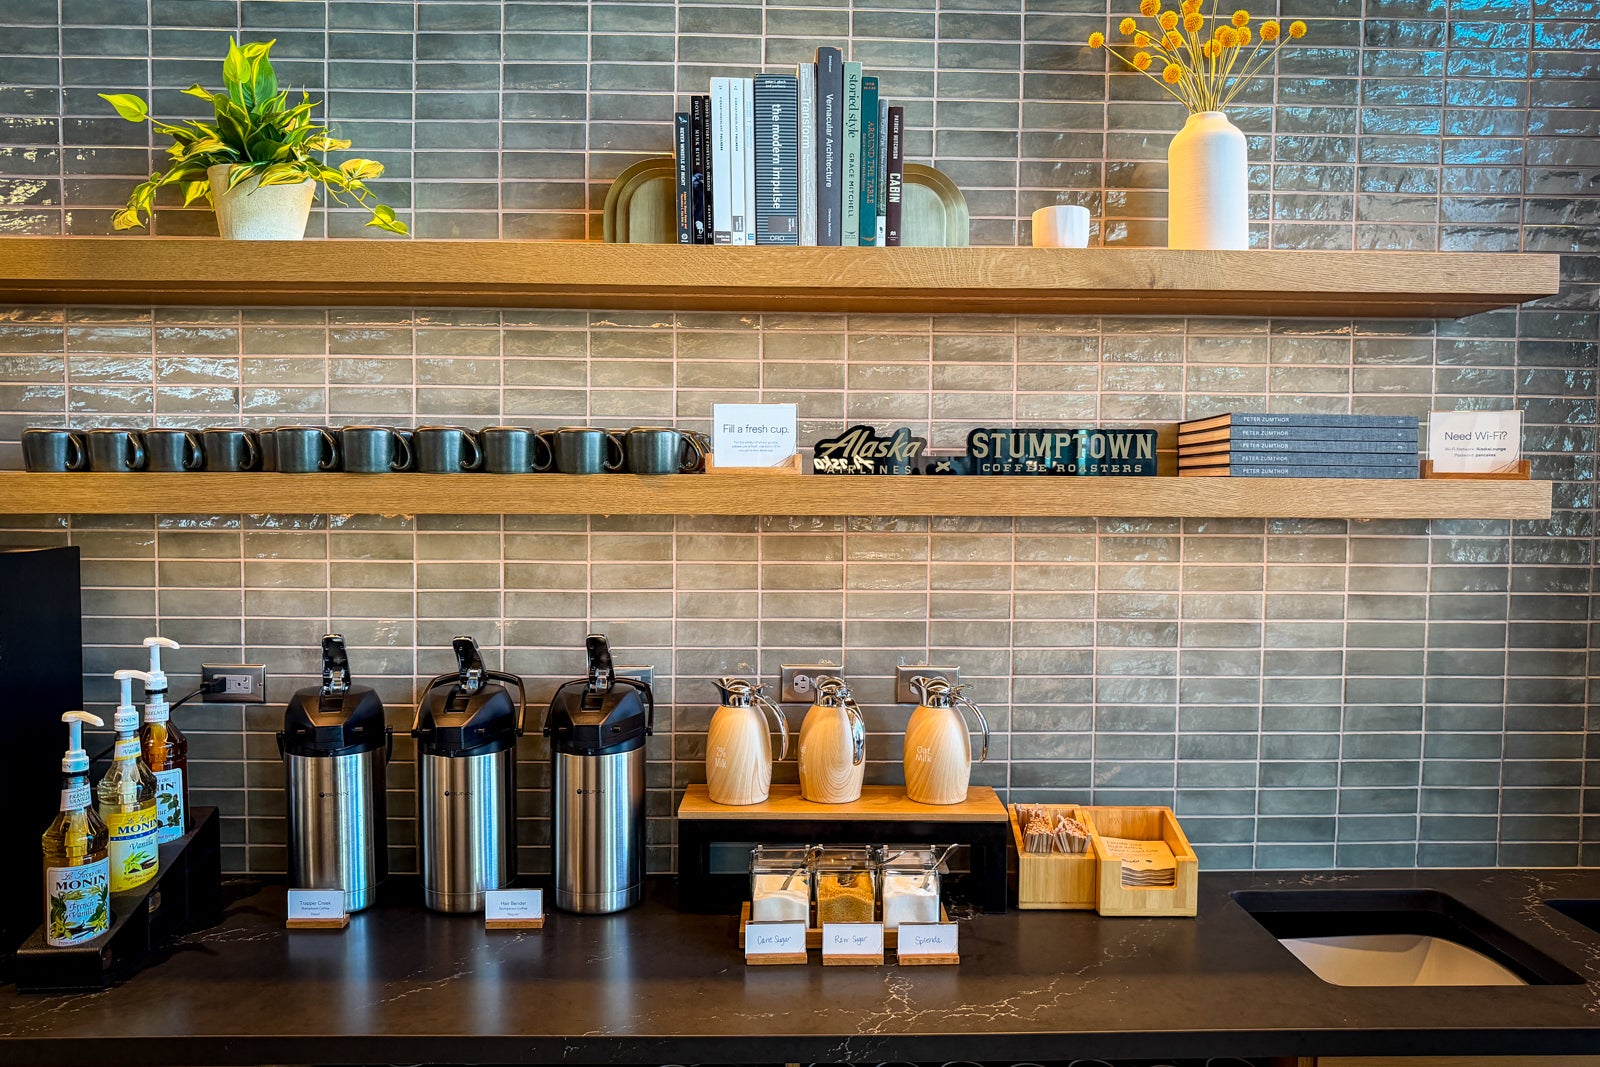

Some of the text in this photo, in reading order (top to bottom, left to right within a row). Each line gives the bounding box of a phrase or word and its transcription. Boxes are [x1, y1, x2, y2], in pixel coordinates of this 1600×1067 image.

[846, 73, 859, 138] storied style
[802, 96, 811, 149] Transform
[771, 104, 782, 209] the modern impulse
[889, 172, 900, 203] CABIN
[723, 424, 735, 433] Fill
[746, 424, 768, 433] fresh
[770, 426, 790, 435] cup.
[1445, 431, 1508, 440] Need Wi-Fi?
[820, 429, 922, 462] Alaska
[972, 432, 1152, 459] STUMPTOWN
[827, 465, 911, 474] AIRLINES
[982, 464, 1142, 473] COFFEE ROASTERS
[916, 745, 931, 755] Oat
[715, 757, 727, 768] Milk
[915, 754, 932, 763] Milk
[118, 819, 158, 834] MONIN
[56, 873, 106, 890] MONIN
[70, 899, 94, 911] French
[69, 908, 95, 919] Vanilla
[757, 935, 792, 946] Cane Sugar
[834, 935, 868, 946] Raw Sugar
[915, 936, 943, 946] Splenda
